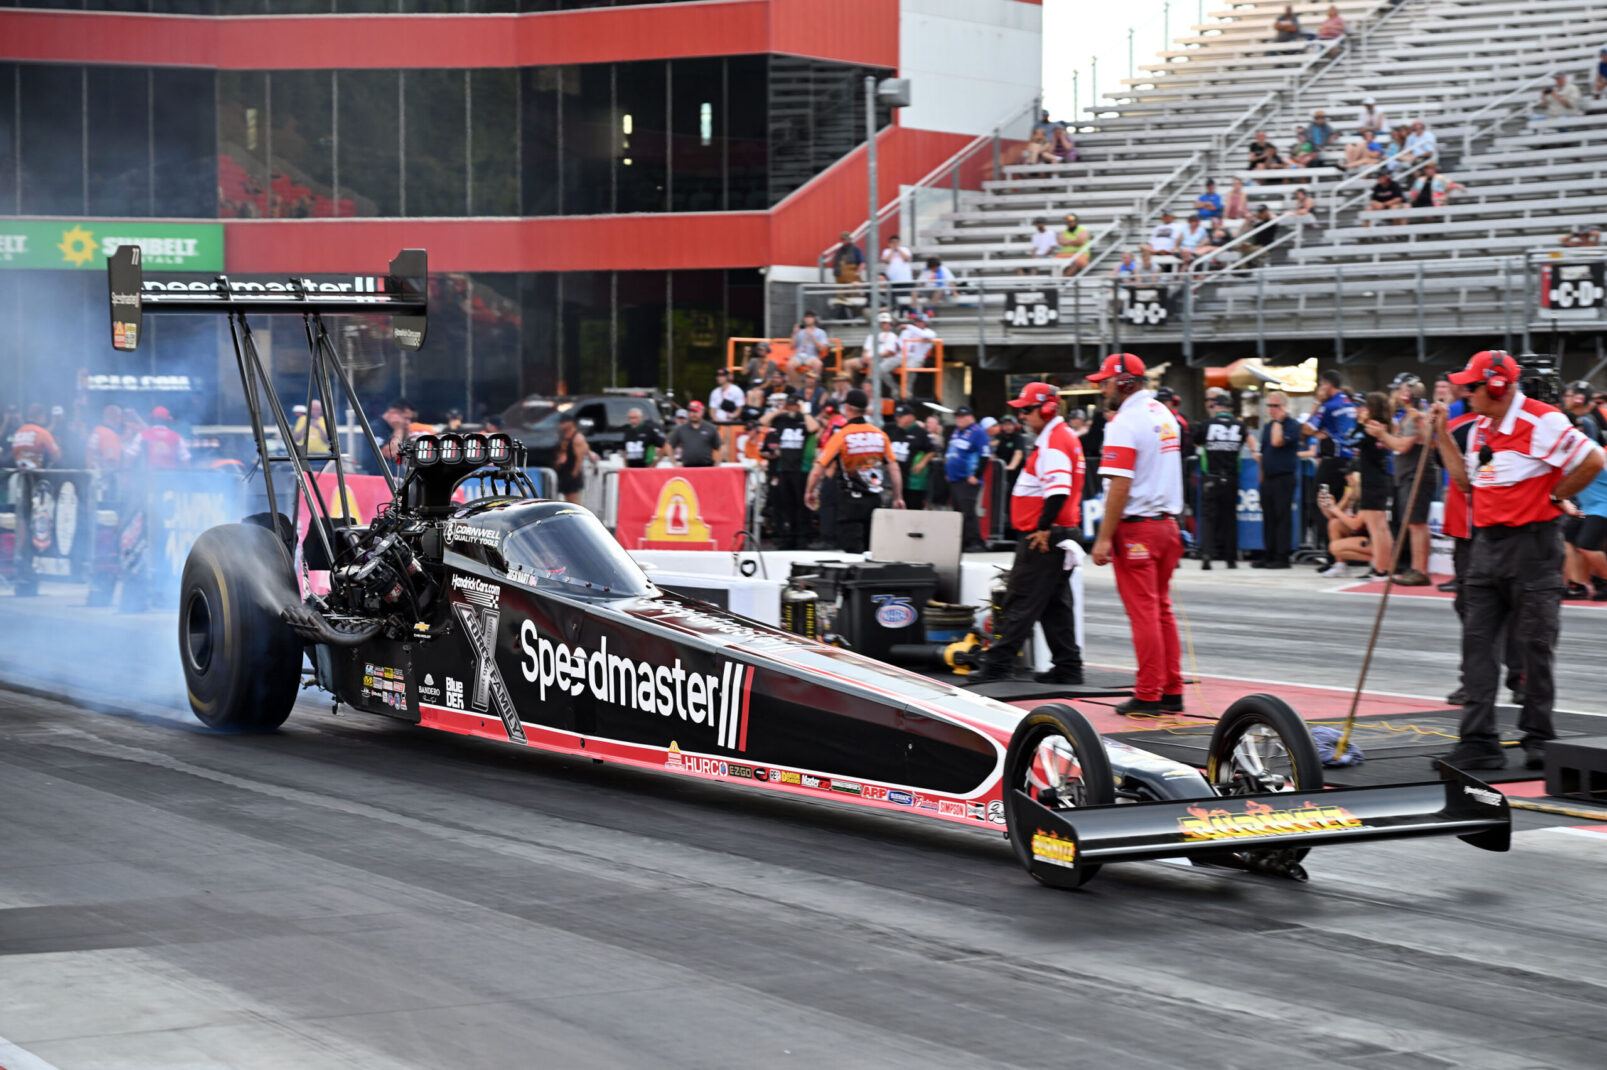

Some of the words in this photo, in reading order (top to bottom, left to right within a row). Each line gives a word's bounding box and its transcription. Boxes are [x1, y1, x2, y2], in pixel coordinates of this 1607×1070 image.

[455, 525, 501, 539] CORNWELL
[454, 534, 479, 544] QUALITY
[480, 538, 499, 547] TOOLS
[466, 614, 492, 669] FORCE
[489, 669, 524, 735] FAMILY
[521, 618, 719, 727] Speedmaster
[418, 685, 441, 697] BANDERO
[684, 756, 728, 777] HURCO
[862, 786, 888, 799] ARP
[939, 800, 964, 817] SIMPSON
